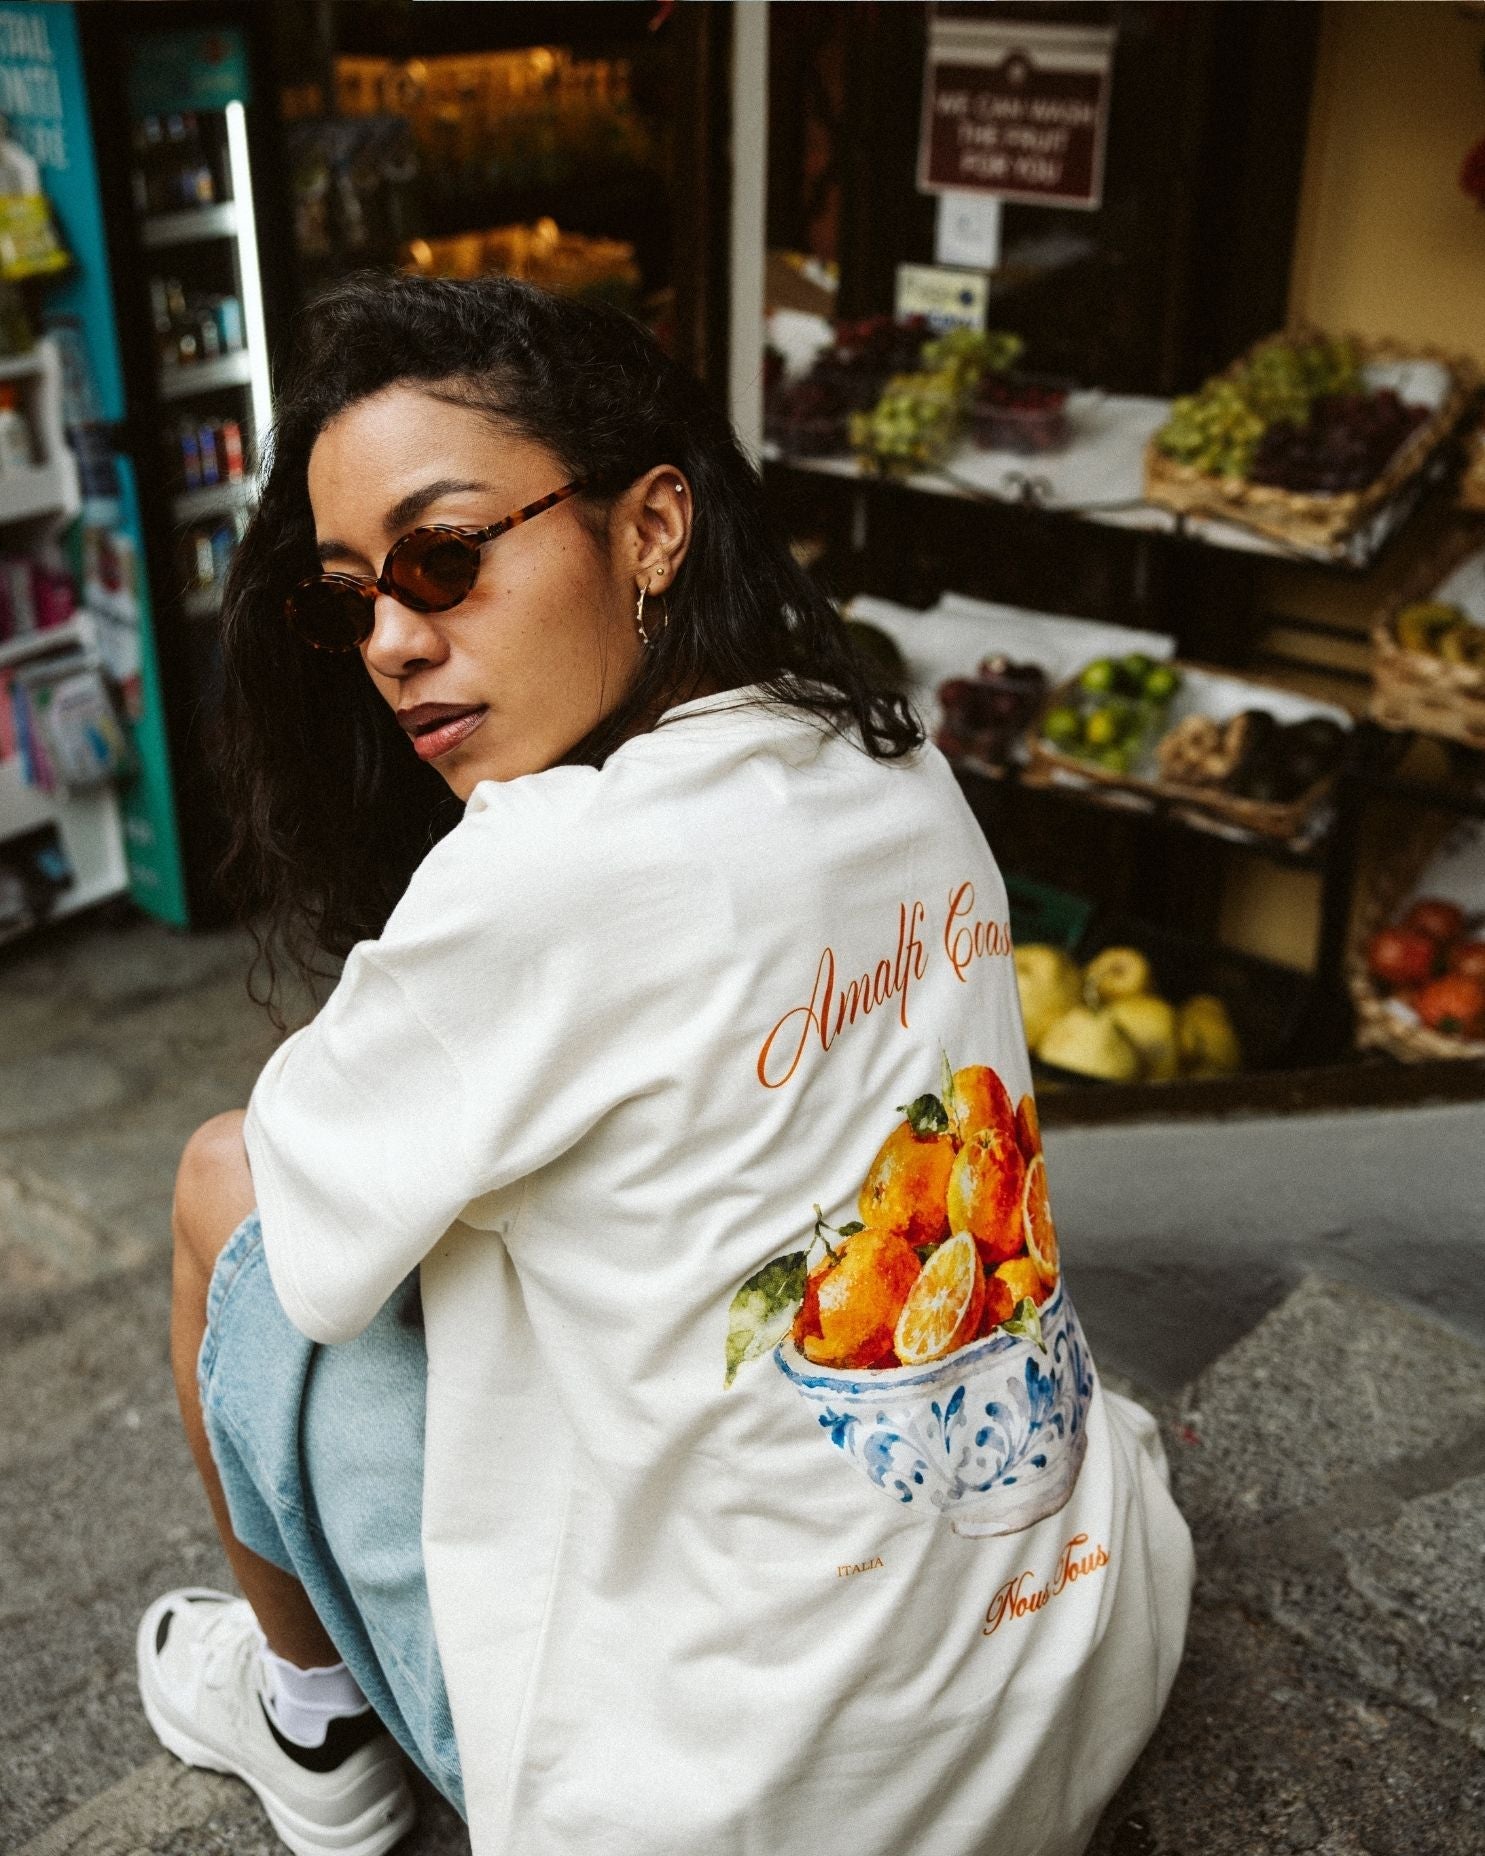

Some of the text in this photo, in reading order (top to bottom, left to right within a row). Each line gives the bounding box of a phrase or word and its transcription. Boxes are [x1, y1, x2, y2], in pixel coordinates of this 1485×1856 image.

[757, 881, 1013, 1089] Amalfi Coas
[836, 1556, 884, 1578] ITALIA
[983, 1532, 1110, 1636] Nous Tous
